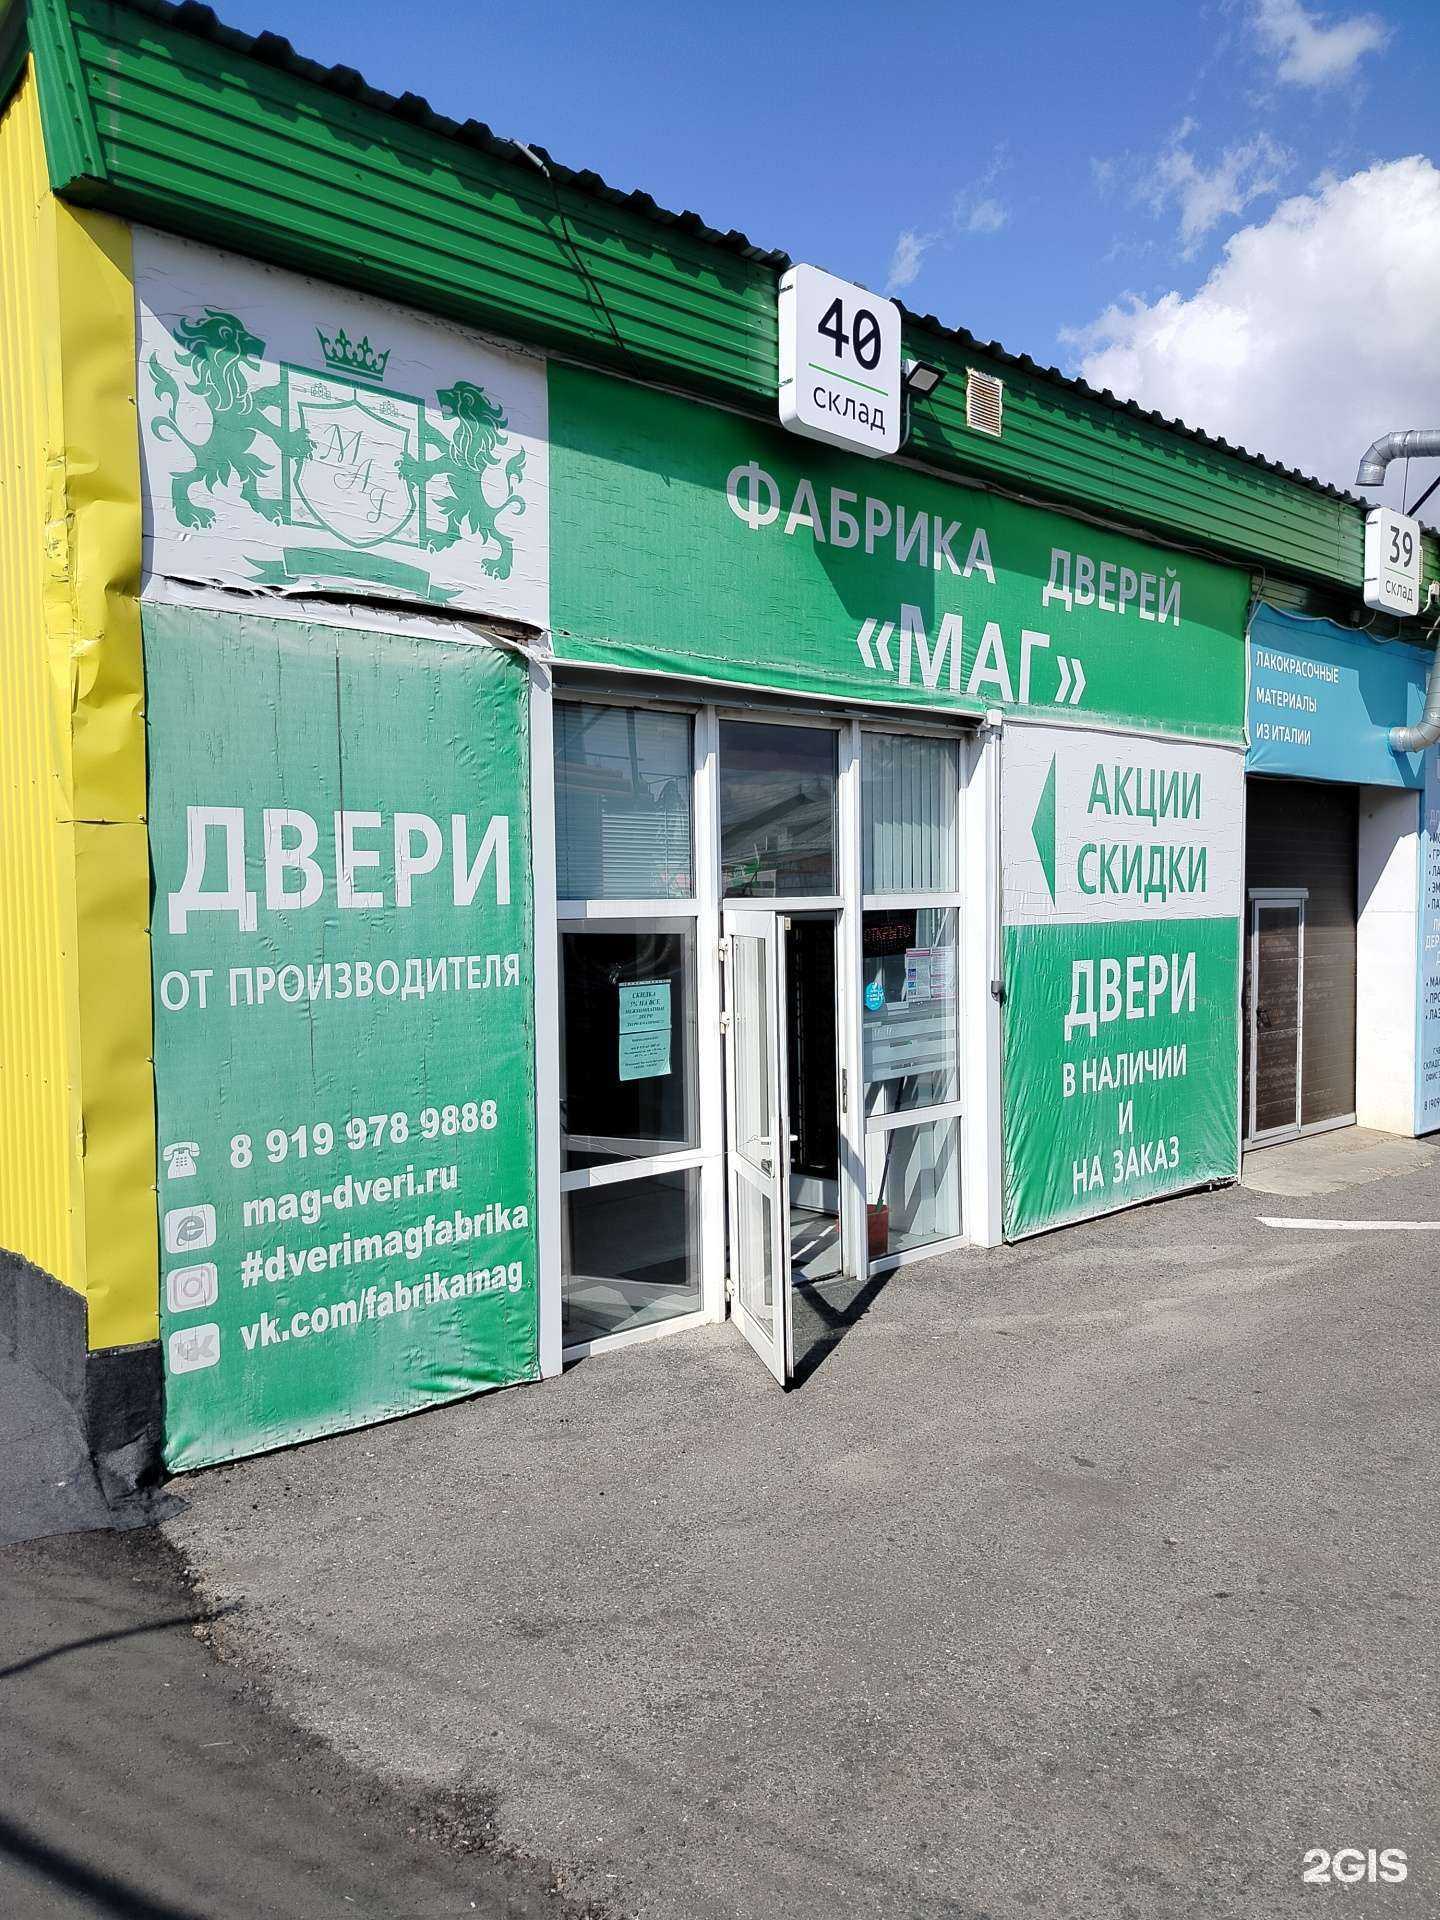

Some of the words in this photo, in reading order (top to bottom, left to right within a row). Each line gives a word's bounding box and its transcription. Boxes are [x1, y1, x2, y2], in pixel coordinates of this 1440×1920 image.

[818, 297, 882, 372] 40
[726, 460, 997, 585] ФАБРИКА
[1042, 547, 1182, 627] ДВЕРЕЙ
[1389, 525, 1414, 568] 39
[856, 603, 1087, 706] «МАГ»
[1256, 650, 1340, 684] ЛАКОКРАСОЧНЫЕ
[1256, 686, 1318, 713] МАТЕРИАЛЫ
[1256, 723, 1270, 740] ИЗ
[1271, 725, 1311, 746] ИТАЛИИ
[1087, 763, 1202, 827] АКЦИИ
[168, 805, 511, 934] ДВЕРИ
[1077, 843, 1208, 903] СКИДКИ
[160, 969, 213, 1011] ОТ
[229, 954, 520, 1007] ПРОИЗВОДИТЕЛЯ
[1064, 951, 1197, 1041] ДВЕРИ
[1062, 1062, 1075, 1098] В
[1082, 1044, 1187, 1094] НАЛИЧИИ
[230, 1134, 253, 1169] 8
[266, 1122, 334, 1163] 919
[347, 1111, 409, 1150] 978
[420, 1099, 498, 1139] 9888
[1119, 1100, 1133, 1135] И
[243, 1163, 459, 1227] mag-dveri.ru
[1073, 1157, 1105, 1194] НА
[1112, 1135, 1180, 1181] ЗАКАЗ
[241, 1203, 529, 1288] #dverimagfabrika
[240, 1260, 523, 1351] vk.com/fabrikamag
